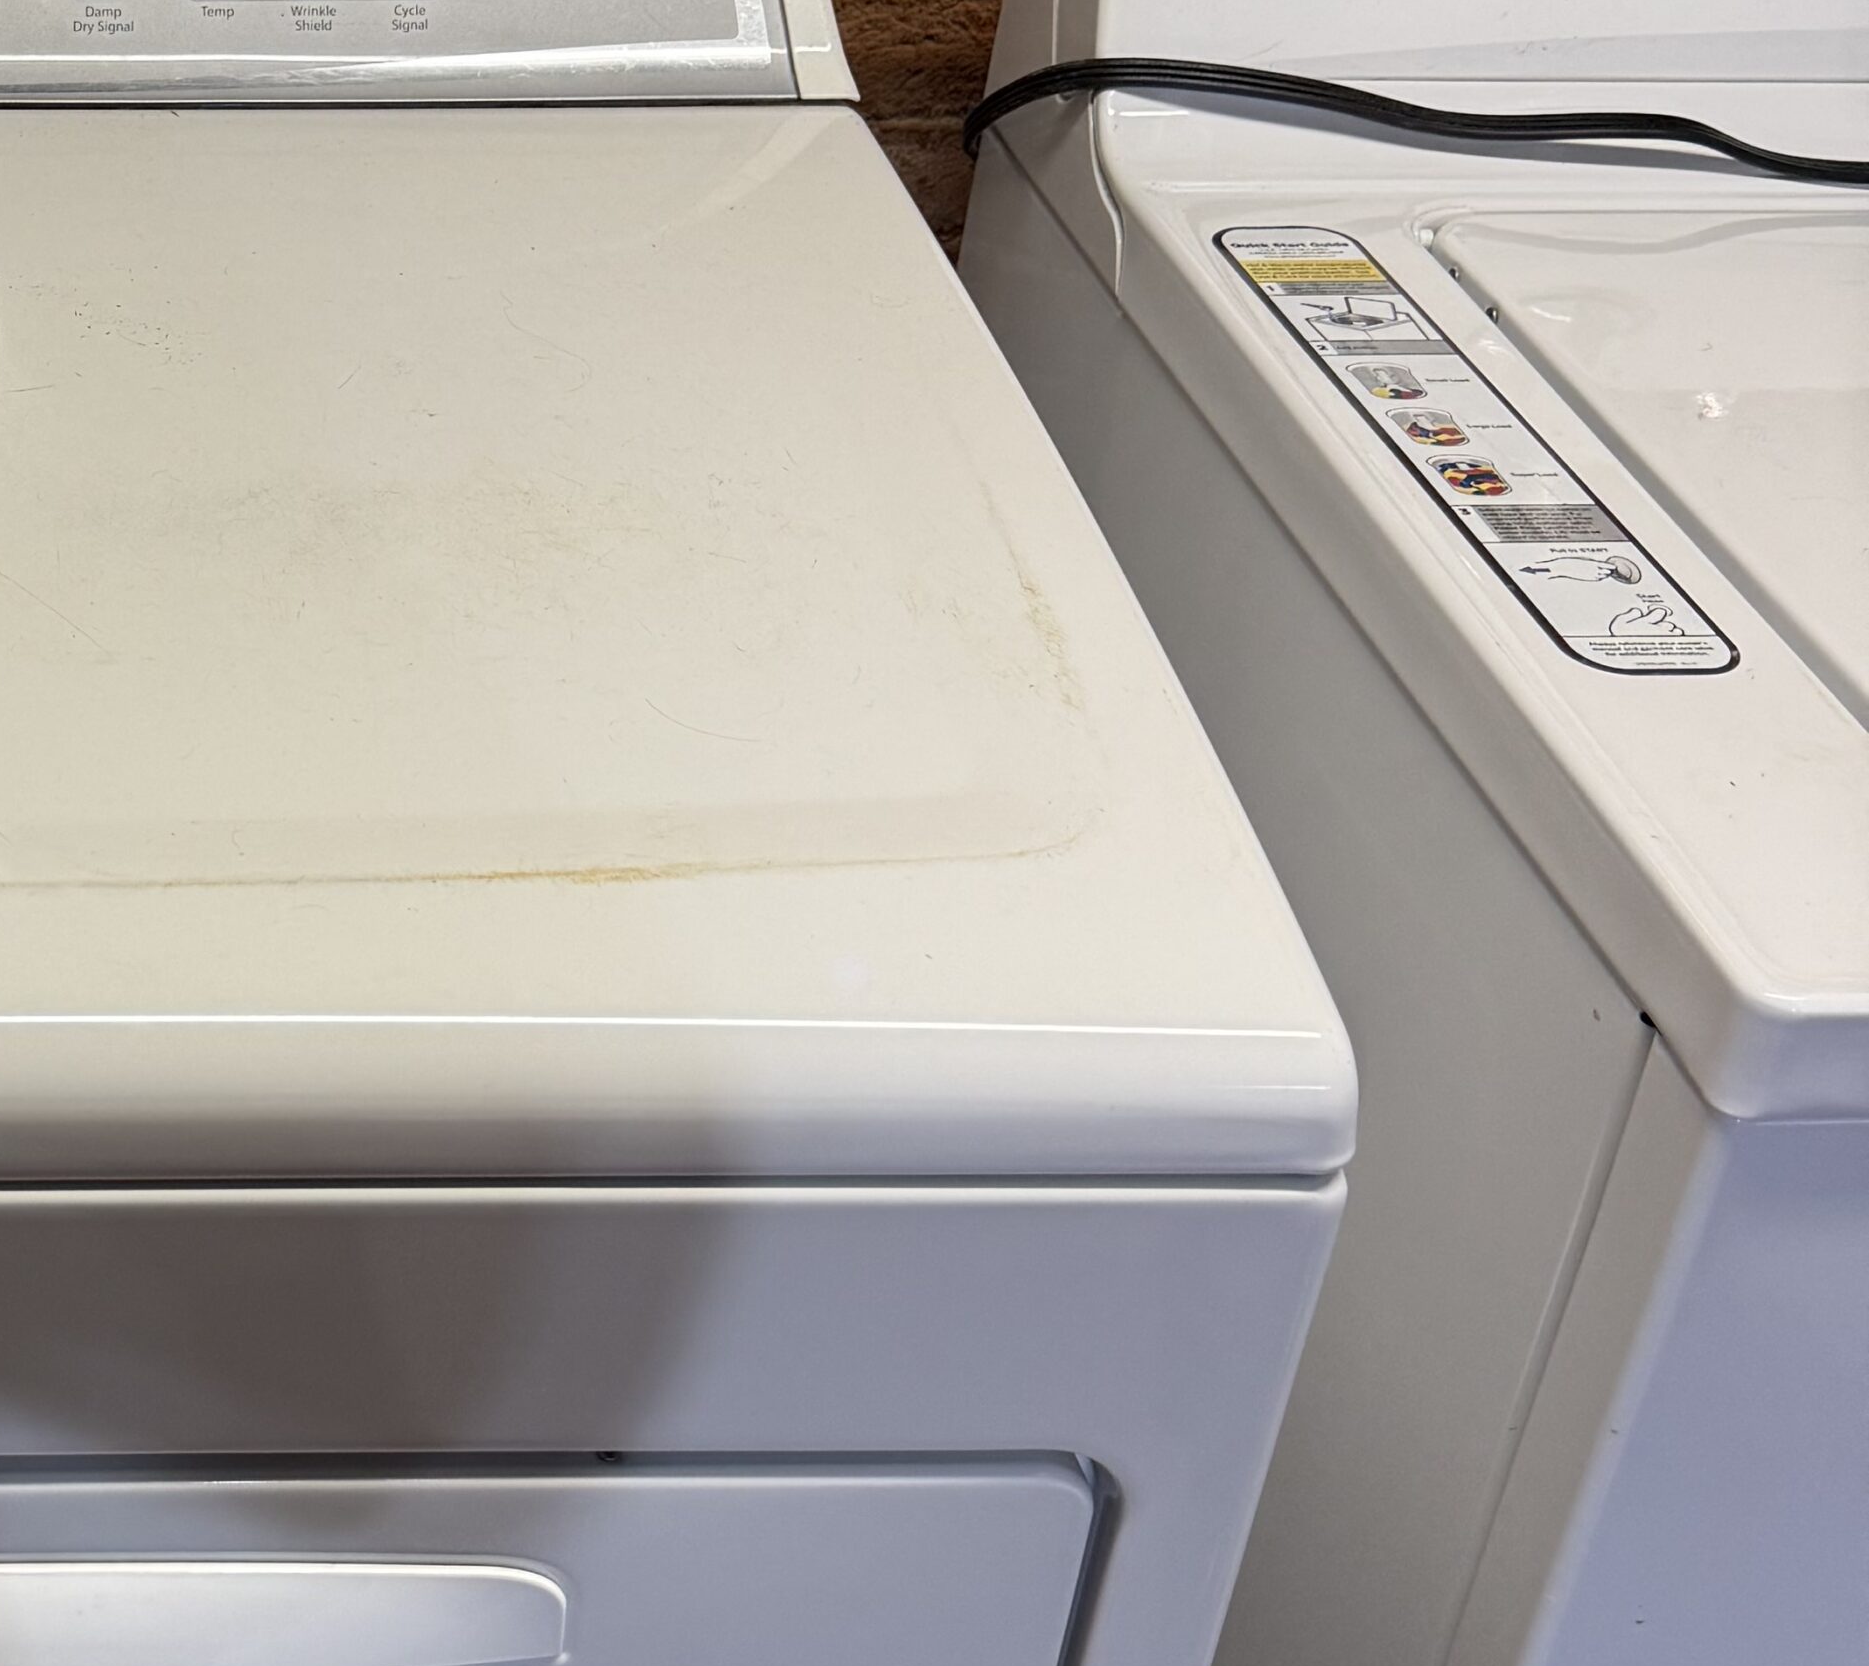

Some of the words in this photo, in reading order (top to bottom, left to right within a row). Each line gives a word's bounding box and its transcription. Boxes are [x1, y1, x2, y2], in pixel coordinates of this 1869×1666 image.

[85, 6, 122, 21] Damp
[201, 6, 235, 20] Temp
[290, 5, 337, 18] Wrinkle
[393, 5, 426, 19] Cycle
[72, 21, 95, 36] Dry
[97, 20, 134, 35] Signal
[294, 19, 333, 32] Shield
[391, 19, 429, 33] Signal
